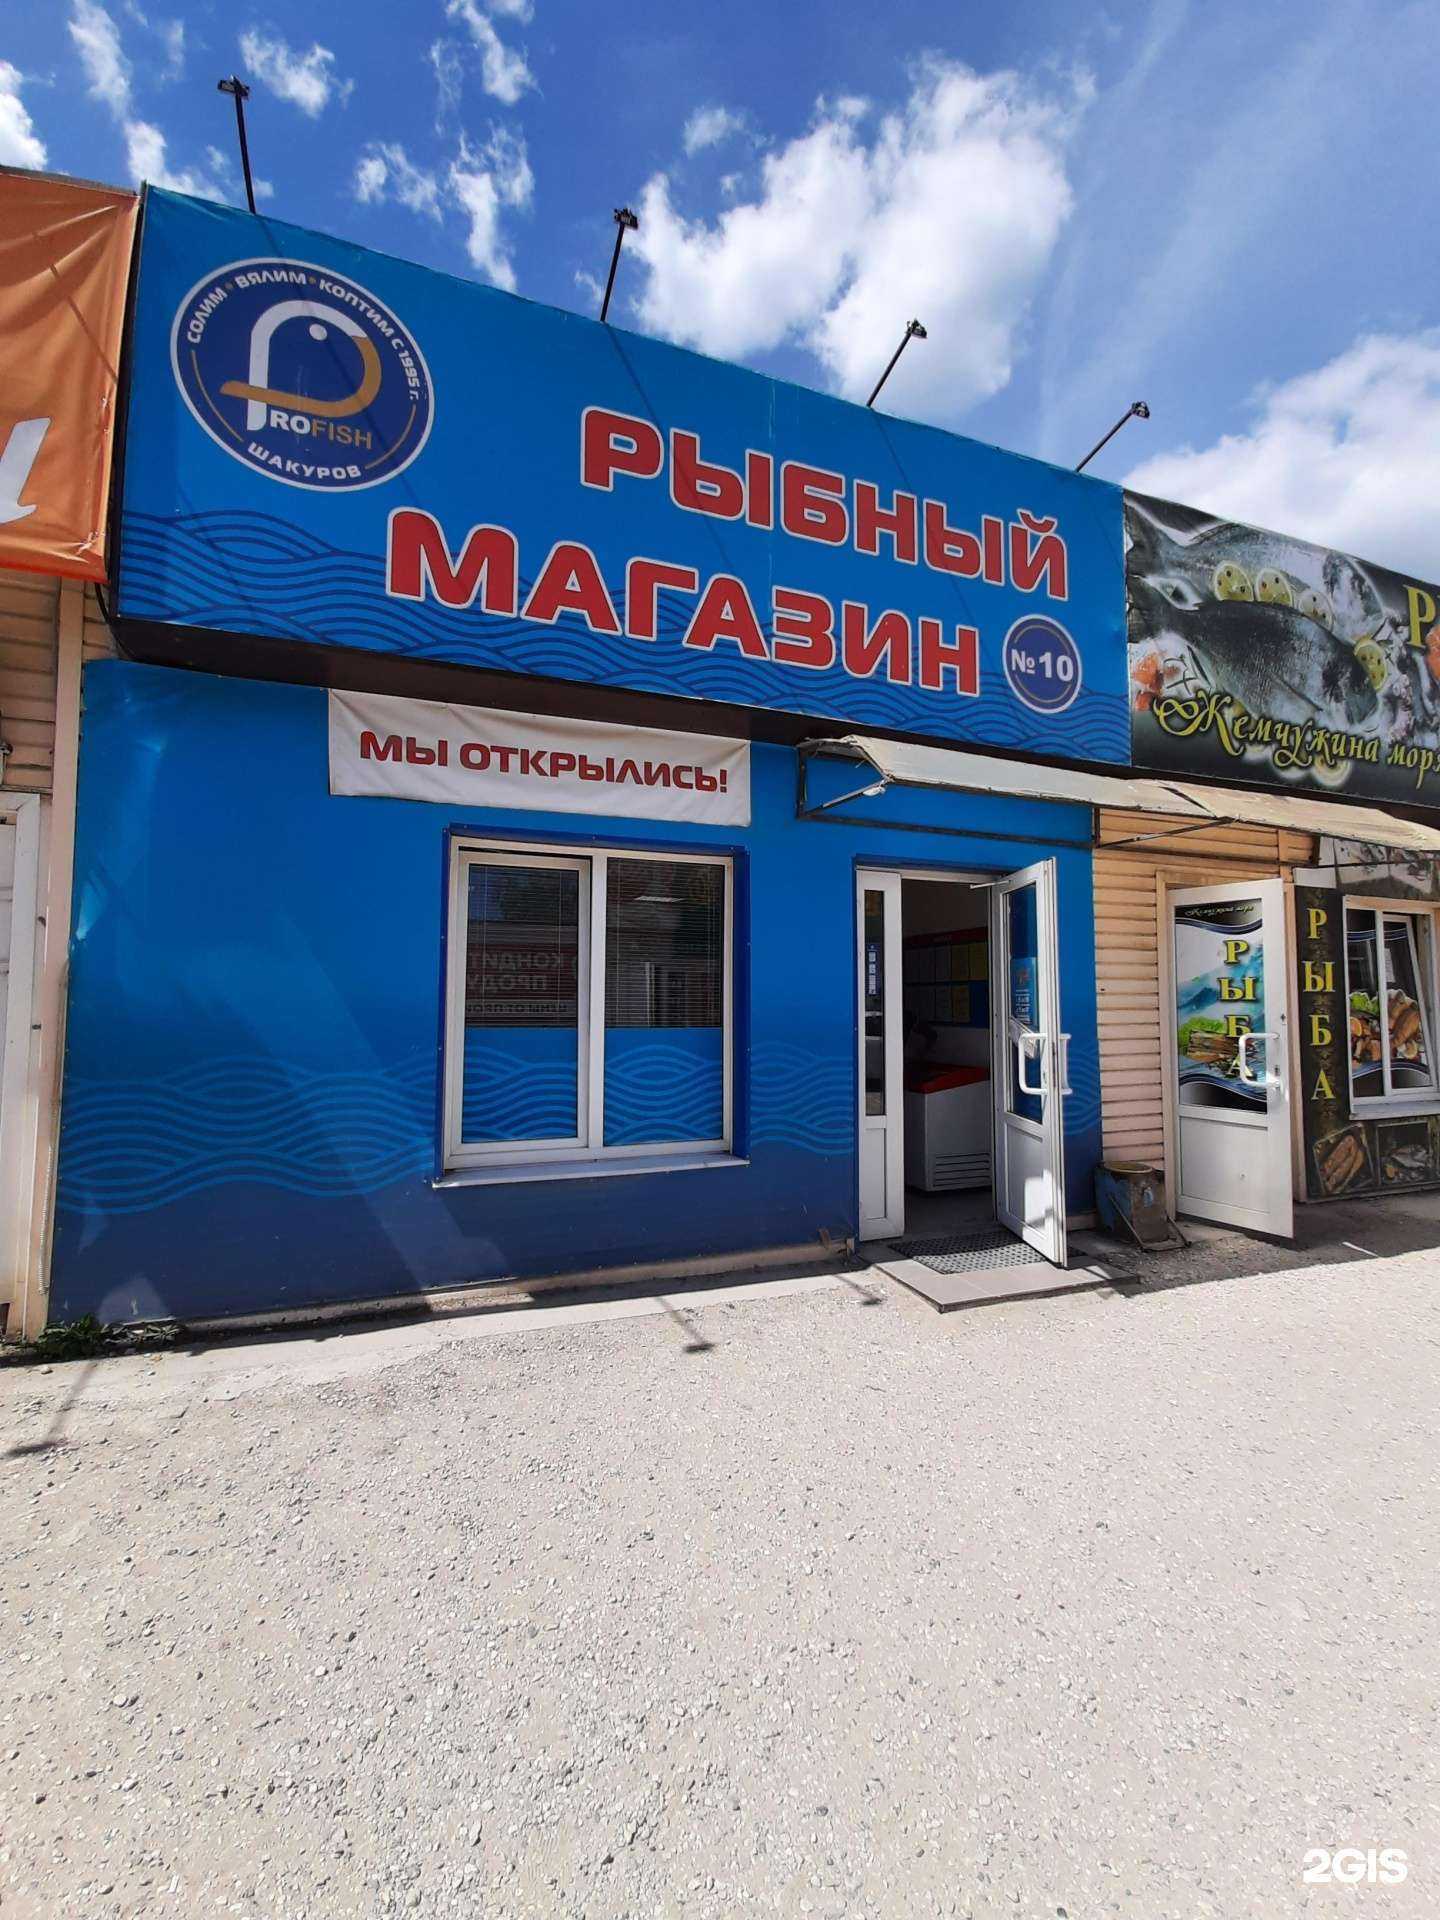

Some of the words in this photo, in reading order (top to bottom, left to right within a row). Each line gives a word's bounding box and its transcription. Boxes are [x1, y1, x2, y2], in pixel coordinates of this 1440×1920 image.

[187, 286, 228, 344] СОЛИМ
[234, 270, 307, 289] ВЯЛИМ
[319, 279, 395, 337] КОПТИМ
[398, 350, 421, 388] 1995
[247, 441, 361, 480] ШАКУРОВ
[581, 406, 1069, 602] РЫБНЫЙ
[386, 506, 980, 698] МАГАЗИН
[360, 730, 448, 768] МЫ
[459, 742, 728, 793] ОТКРЫЛИСЬ!
[1153, 689, 1380, 768] Жемчужина
[1302, 907, 1336, 1100] РЫБА
